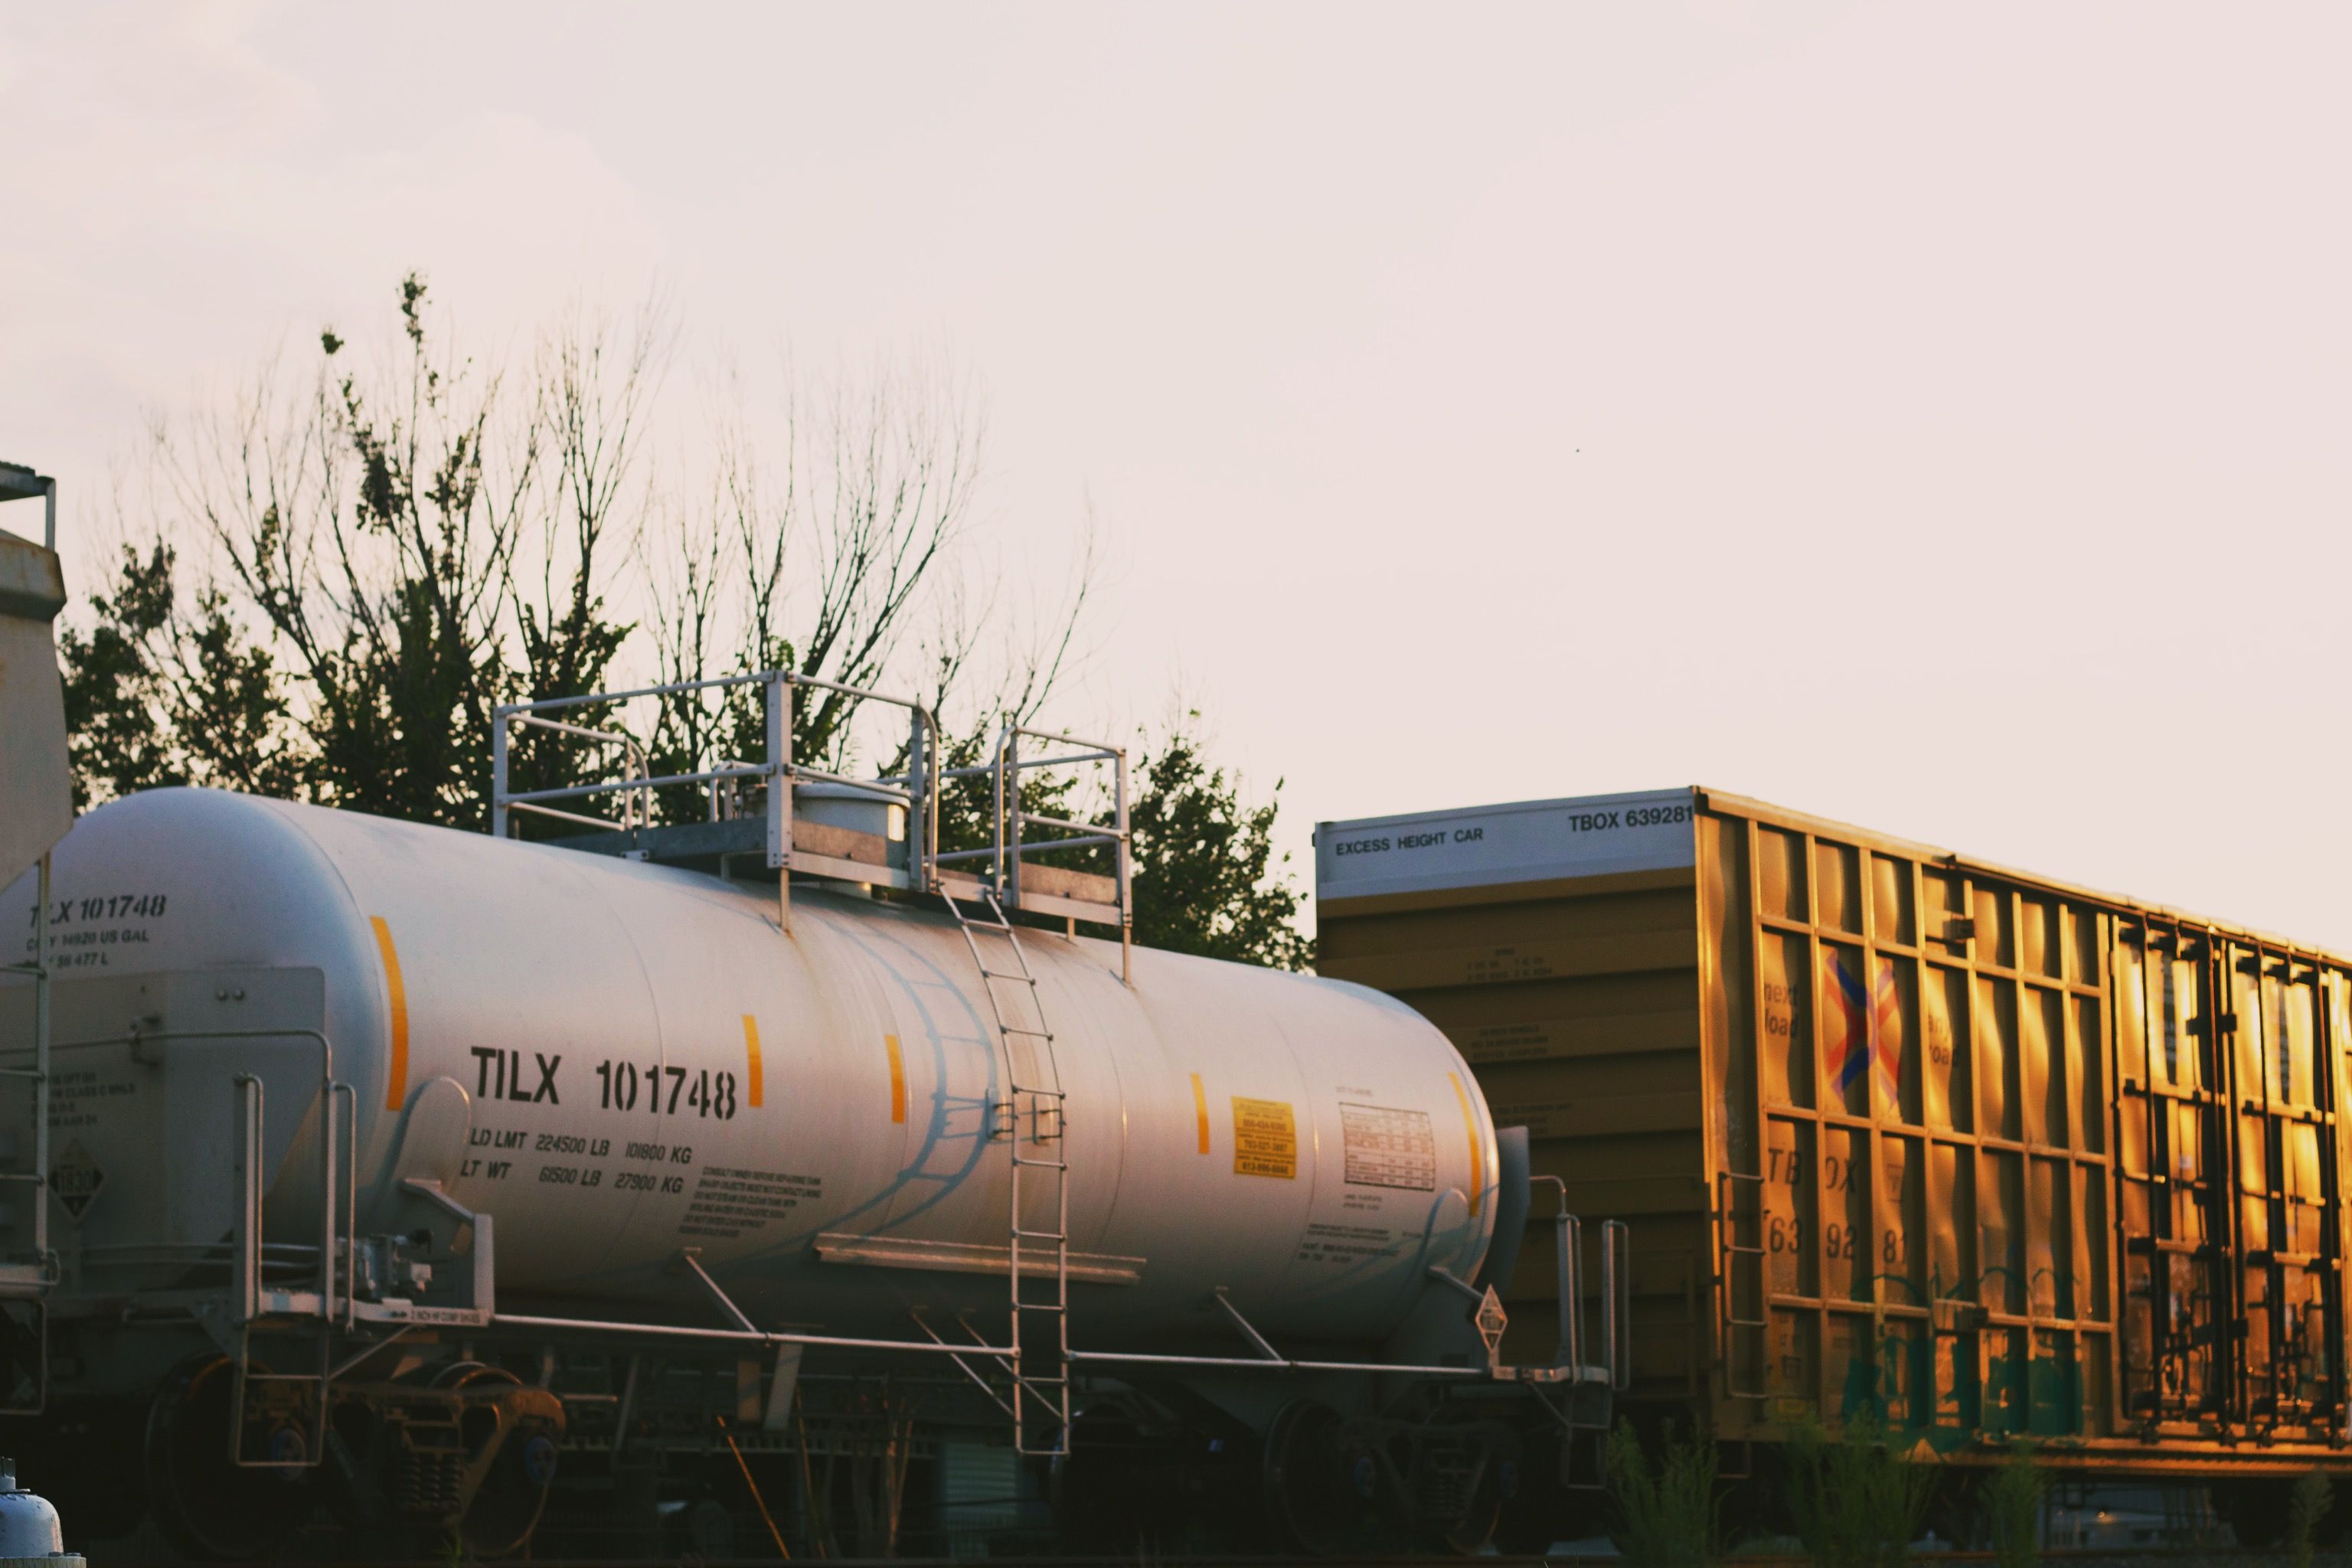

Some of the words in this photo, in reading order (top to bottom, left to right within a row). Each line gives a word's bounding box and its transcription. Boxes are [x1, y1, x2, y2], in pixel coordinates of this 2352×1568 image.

[1569, 810, 1620, 833] TBOX
[1625, 805, 1693, 828] 639281
[1336, 837, 1390, 855] EXCESS
[1397, 831, 1447, 850] HEIGHT
[1455, 828, 1484, 844] CAR
[30, 900, 74, 928] TX
[81, 895, 167, 920] 101748
[100, 929, 117, 944] US
[122, 929, 149, 942] GAL
[471, 1046, 562, 1105] TILX
[596, 1059, 737, 1121] 101748
[469, 1128, 492, 1147] LD
[495, 1129, 528, 1151] LMT
[535, 1133, 587, 1155] 224500
[590, 1138, 610, 1157] LB
[625, 1142, 666, 1162] 101800
[670, 1145, 693, 1165] KG
[460, 1159, 483, 1178] LT
[486, 1161, 511, 1181] WT
[539, 1167, 578, 1186] 61500
[580, 1169, 602, 1187] LB
[614, 1172, 657, 1192] 27900
[661, 1174, 684, 1194] KG
